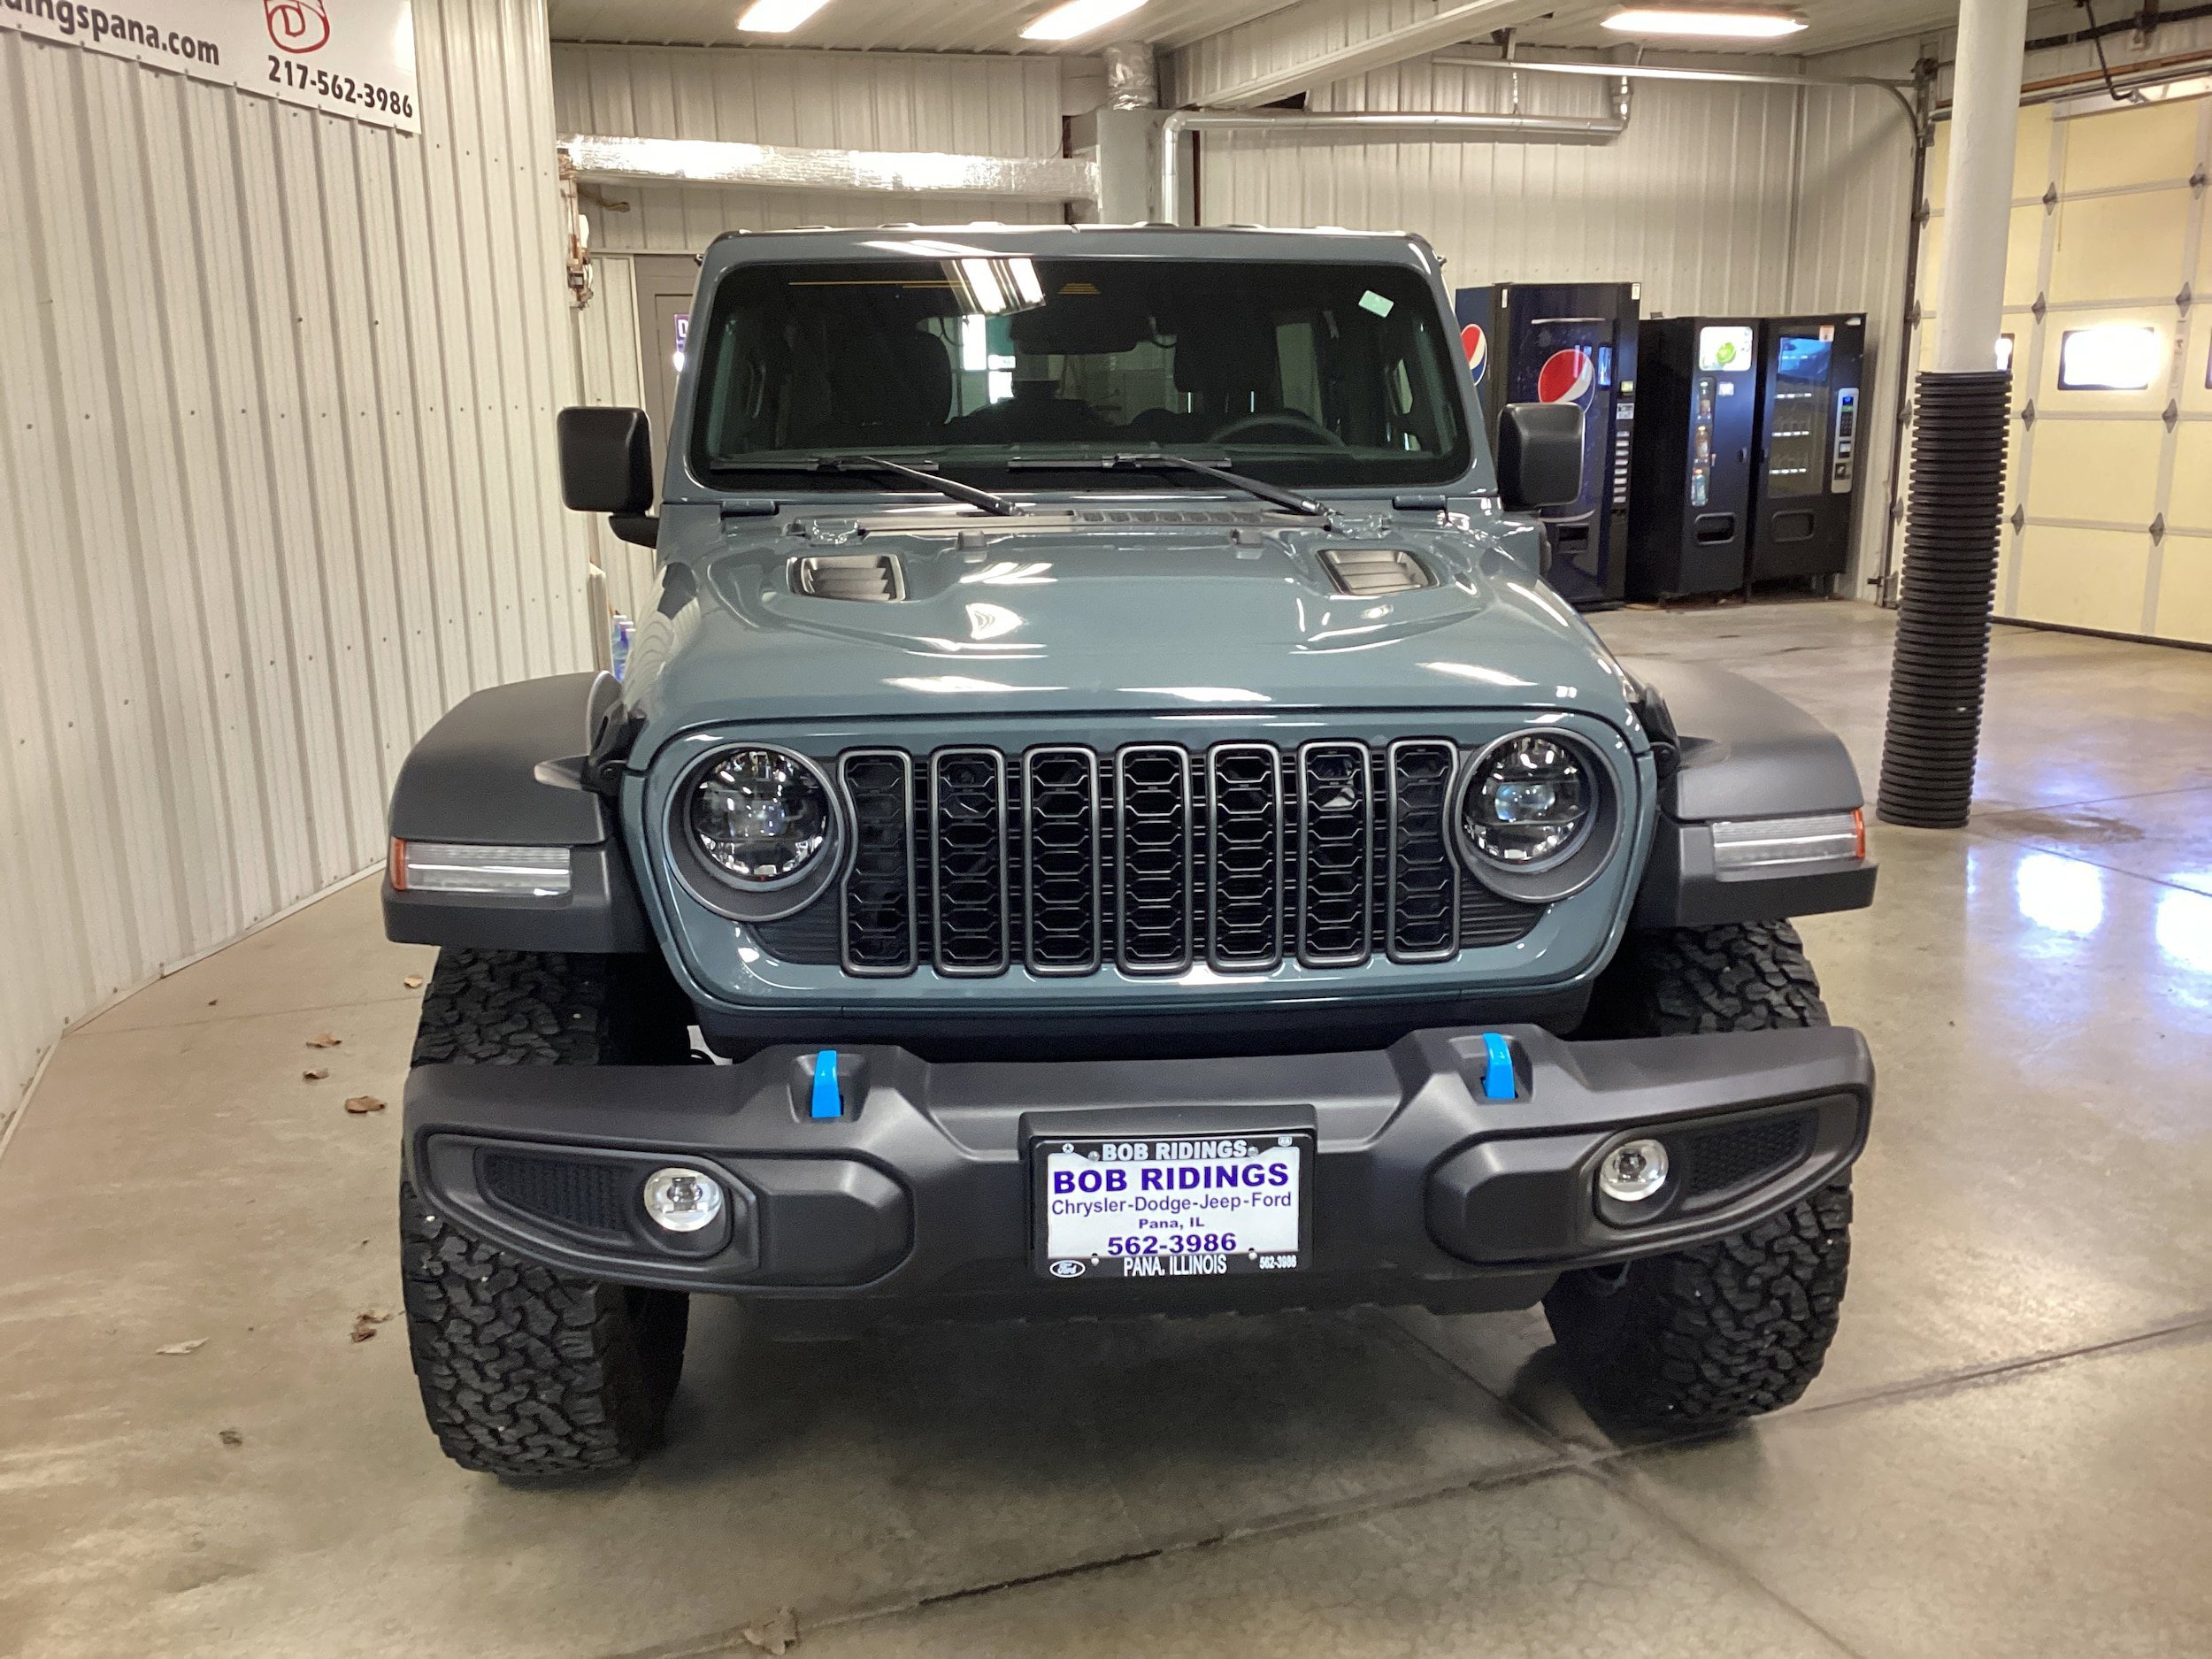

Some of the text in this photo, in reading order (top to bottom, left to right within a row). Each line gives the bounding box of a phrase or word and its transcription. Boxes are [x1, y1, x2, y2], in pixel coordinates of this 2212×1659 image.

[268, 55, 413, 118] 217-562-3986
[1102, 1139, 1248, 1162] BOB RIDINGS
[1054, 1163, 1289, 1194] BOB RIDINGS
[1051, 1192, 1292, 1217] Chrysler-Dodge-Jeep-Ford
[1139, 1217, 1205, 1230] Pana, IL
[1107, 1233, 1237, 1256] 562-3986
[1169, 1255, 1227, 1275] ILLINOIS
